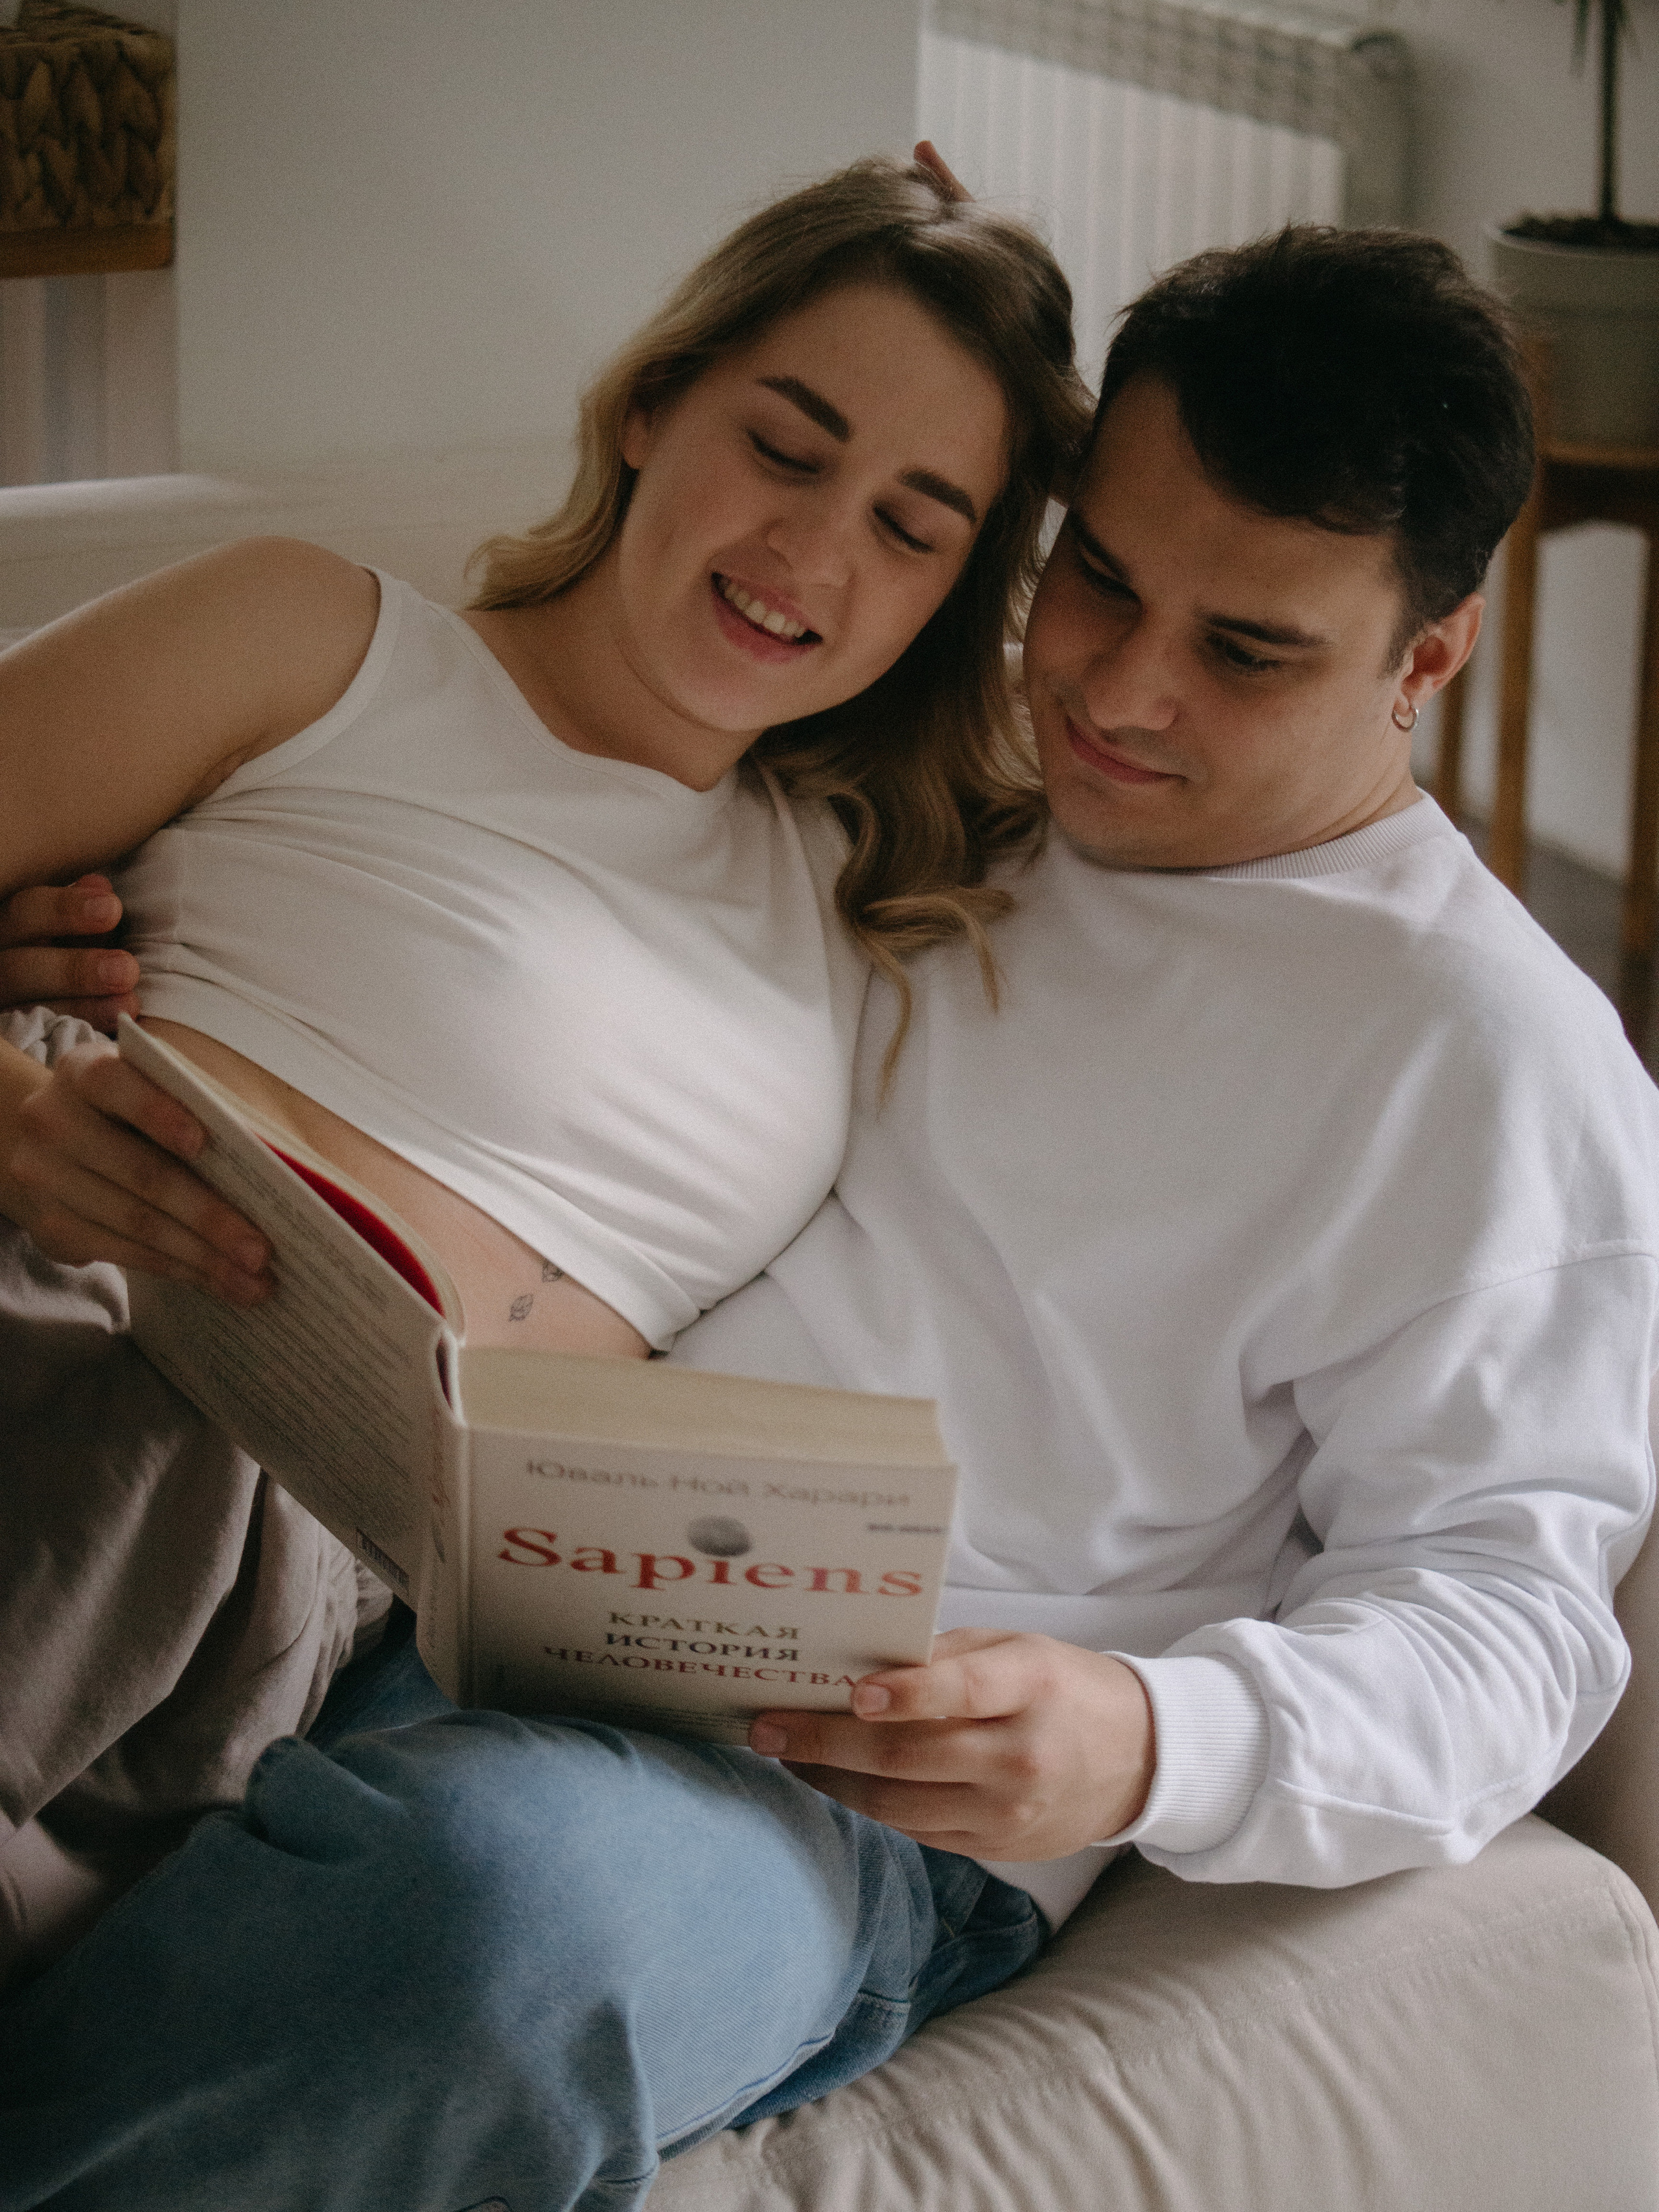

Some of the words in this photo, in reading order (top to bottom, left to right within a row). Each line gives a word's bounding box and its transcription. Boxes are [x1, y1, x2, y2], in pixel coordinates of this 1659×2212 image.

[527, 1460, 658, 1488] Юваль
[670, 1474, 750, 1496] Ной
[764, 1482, 910, 1508] Харари
[498, 1527, 923, 1596] Sapiens
[609, 1612, 801, 1640] КРАТКАЯ
[544, 1647, 856, 1687] ЧЕЛОВЕЧЕСТВА
[605, 1633, 800, 1661] ИСТОРИЯ
